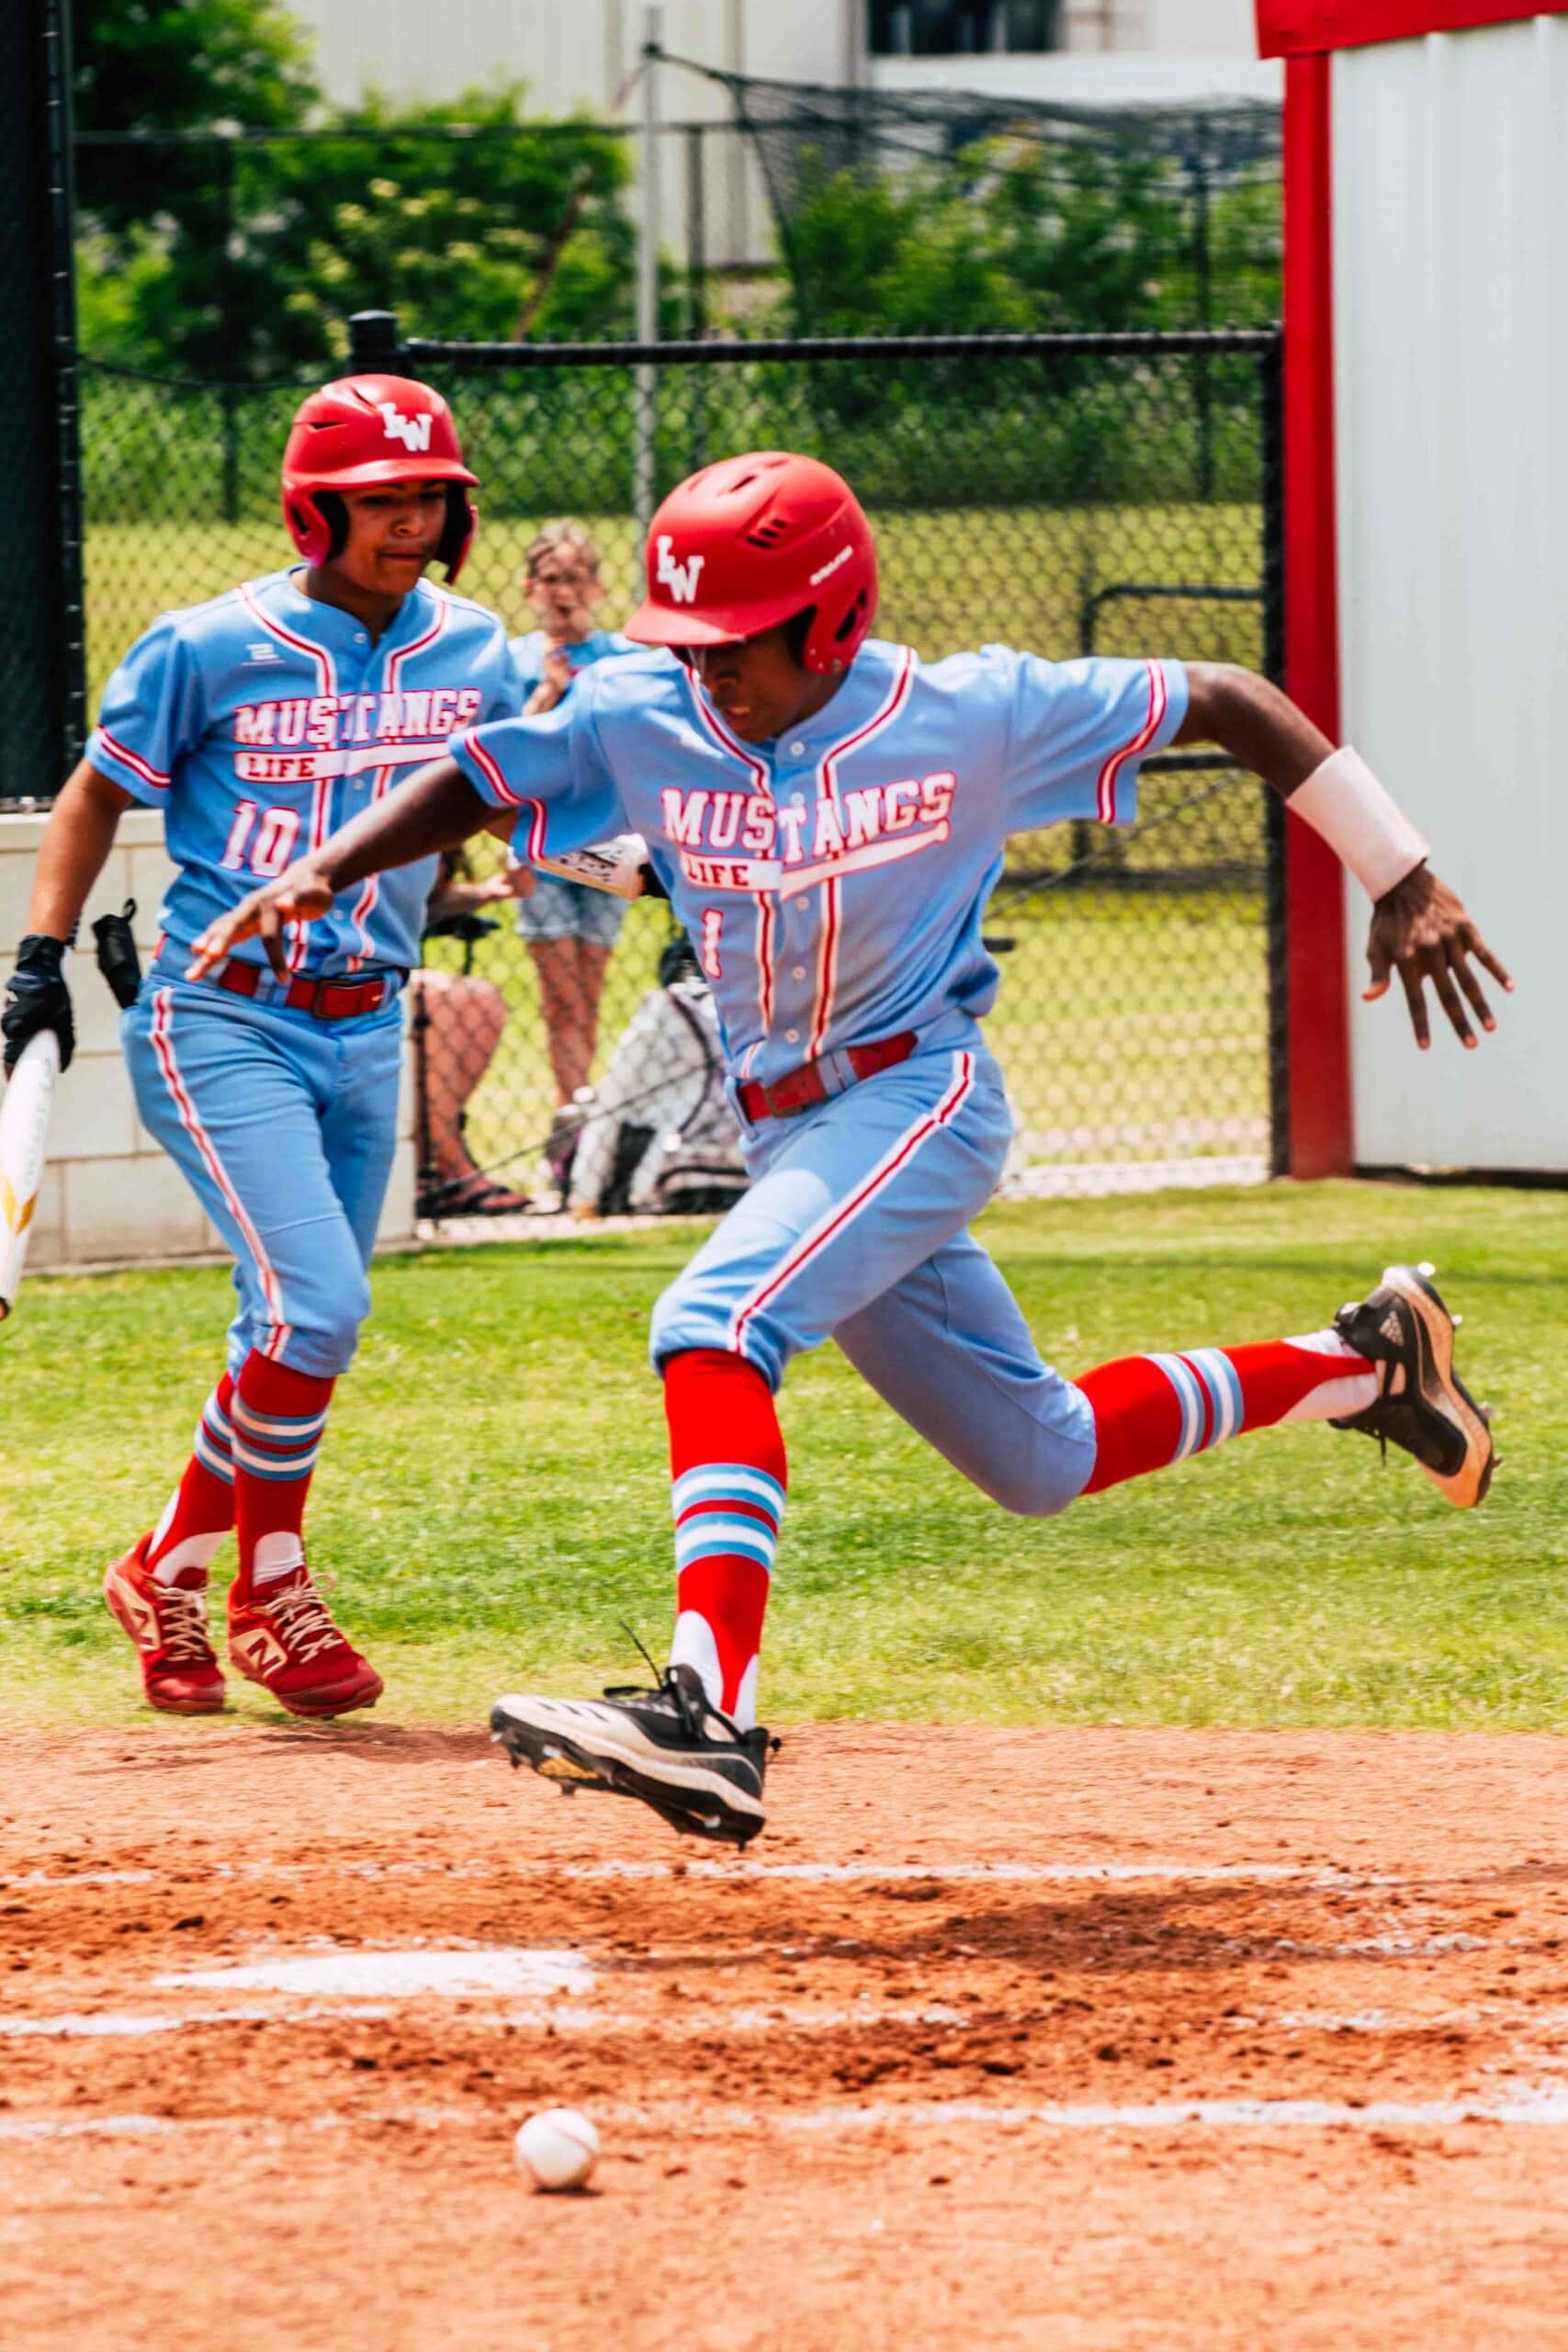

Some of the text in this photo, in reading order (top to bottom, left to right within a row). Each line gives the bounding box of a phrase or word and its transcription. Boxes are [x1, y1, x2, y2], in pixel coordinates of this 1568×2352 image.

[377, 402, 434, 452] LW
[657, 535, 705, 604] LW
[233, 687, 482, 747] MUSTANGS
[247, 756, 316, 778] LIFE
[218, 797, 302, 879] 10
[660, 770, 957, 865] MUSTANGS
[686, 859, 750, 887] LIFE
[702, 908, 724, 980] 1
